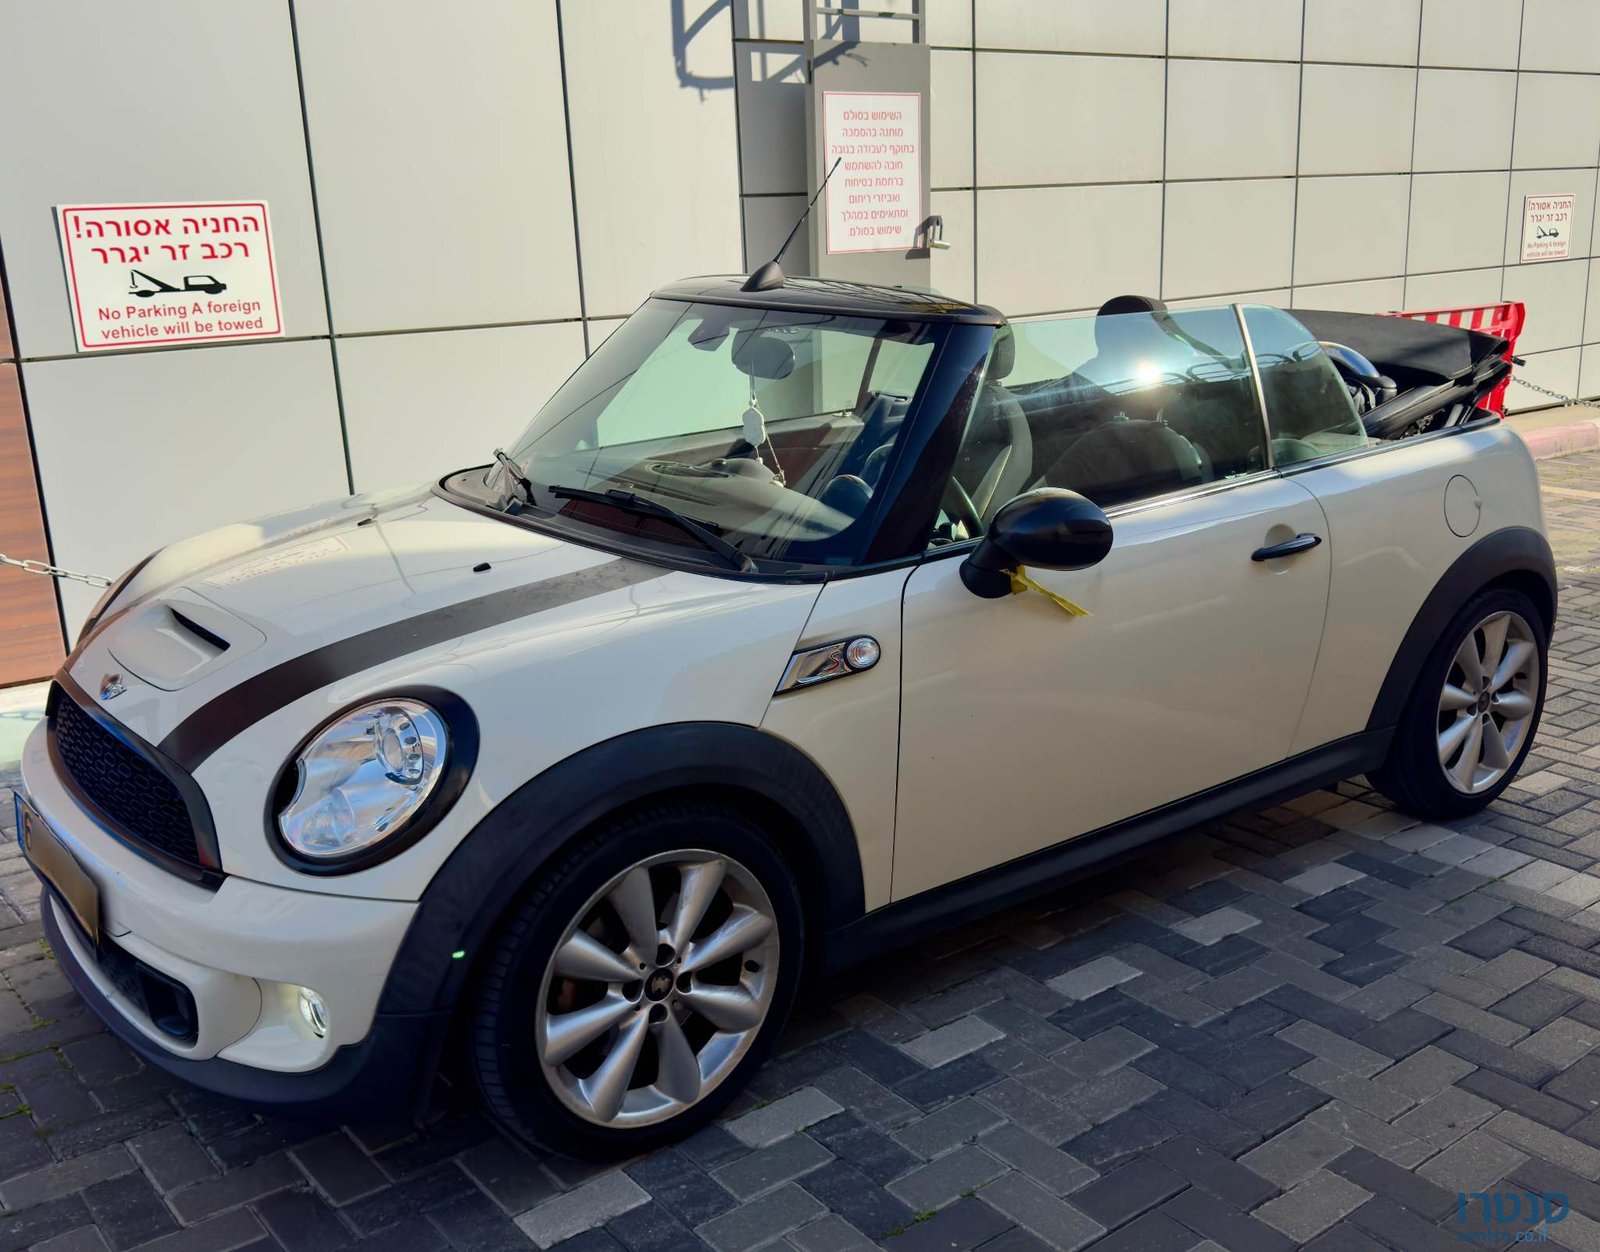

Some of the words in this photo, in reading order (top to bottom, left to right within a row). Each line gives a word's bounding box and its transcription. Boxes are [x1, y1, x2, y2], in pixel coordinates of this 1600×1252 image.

[843, 110, 869, 121] בסולם
[871, 111, 902, 121] השימוש
[842, 127, 877, 137] בהסמכה
[879, 127, 904, 137] מותנה
[857, 143, 887, 154] לעבודה
[889, 144, 915, 156] בתוקף
[844, 159, 882, 171] להשתמש
[884, 160, 903, 170] חובה
[844, 178, 873, 187] בטיחות
[875, 177, 904, 186] ברתמת
[848, 194, 871, 204] ריתום
[873, 193, 900, 202] ואביזרי
[1528, 200, 1551, 211] אסורה!
[1552, 200, 1572, 209] החניה
[841, 209, 869, 222] במהלך
[870, 208, 909, 218] ומתאימים
[1546, 213, 1554, 222] זר
[1555, 212, 1568, 222] רכב
[1530, 214, 1545, 223] יגרר
[72, 215, 172, 239] אסורה!
[182, 216, 260, 234] החניה
[876, 225, 902, 235] שימוש
[90, 245, 151, 265] יגרר
[160, 243, 190, 261] זר
[199, 241, 250, 260] רכב
[98, 307, 121, 321] No
[125, 303, 188, 321] Parking
[191, 302, 204, 315] A
[206, 299, 262, 315] foreign
[100, 322, 159, 341] vehicle
[163, 319, 191, 336] will
[194, 320, 214, 334] be
[217, 316, 264, 332] towed
